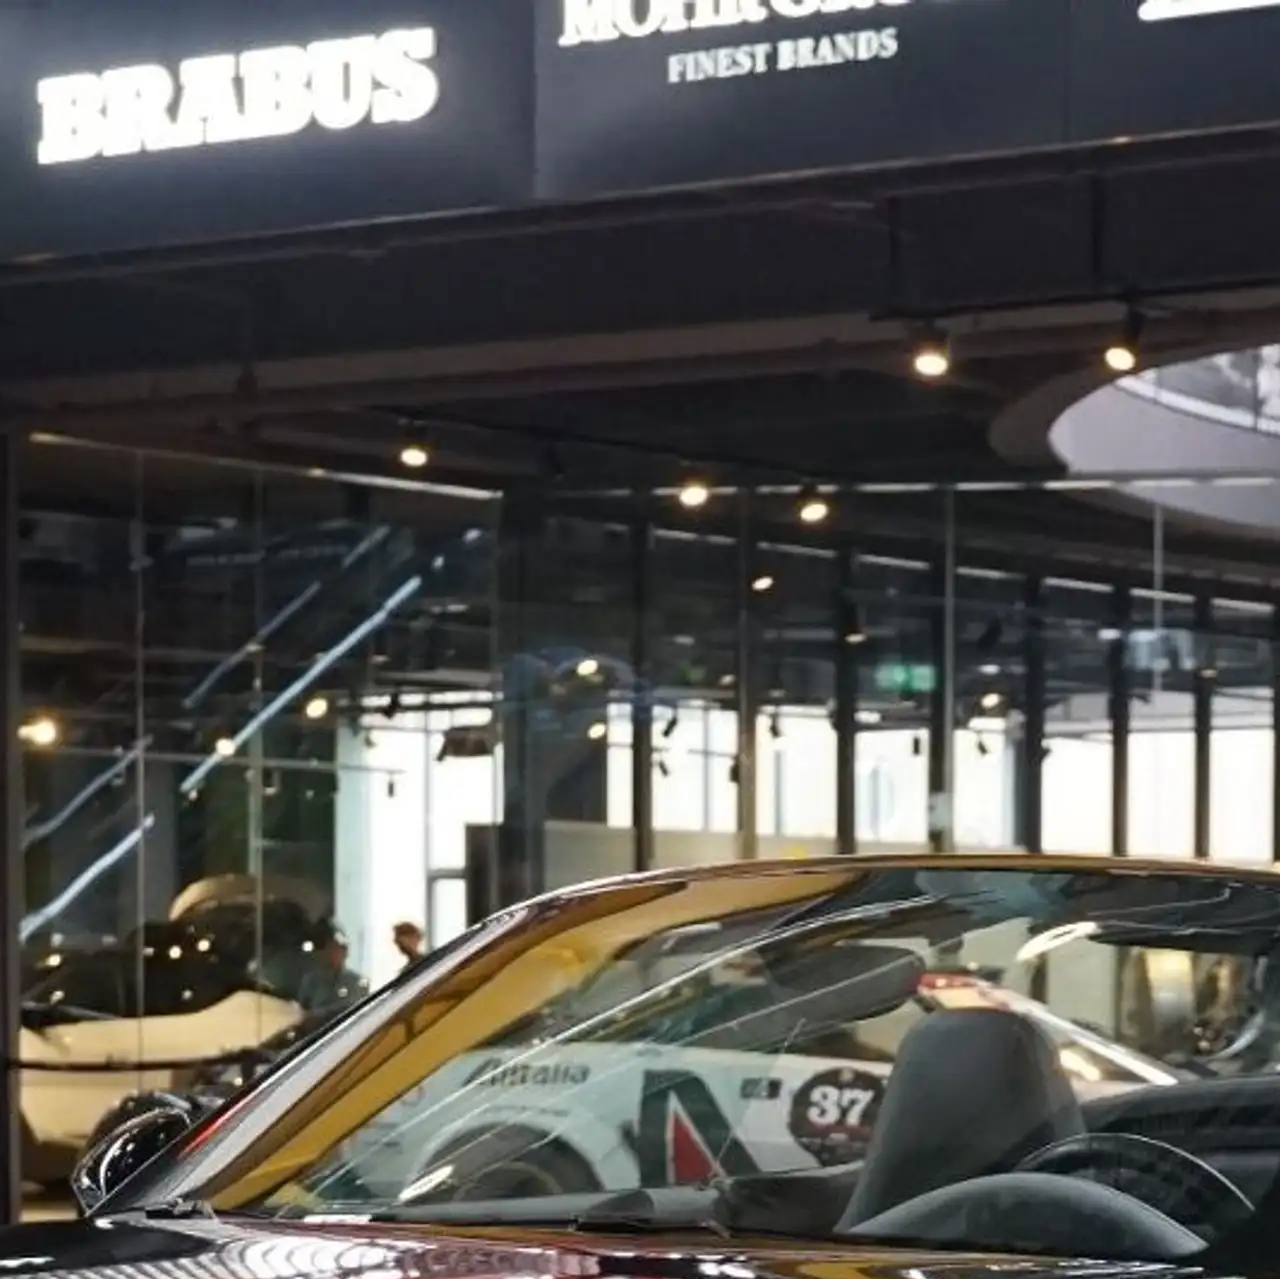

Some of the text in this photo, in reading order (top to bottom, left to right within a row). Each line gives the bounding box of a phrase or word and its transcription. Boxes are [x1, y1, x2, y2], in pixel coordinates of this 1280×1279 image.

[668, 27, 899, 83] FINEST BRANDS
[37, 27, 439, 164] BRABUS
[806, 1085, 875, 1127] 37
